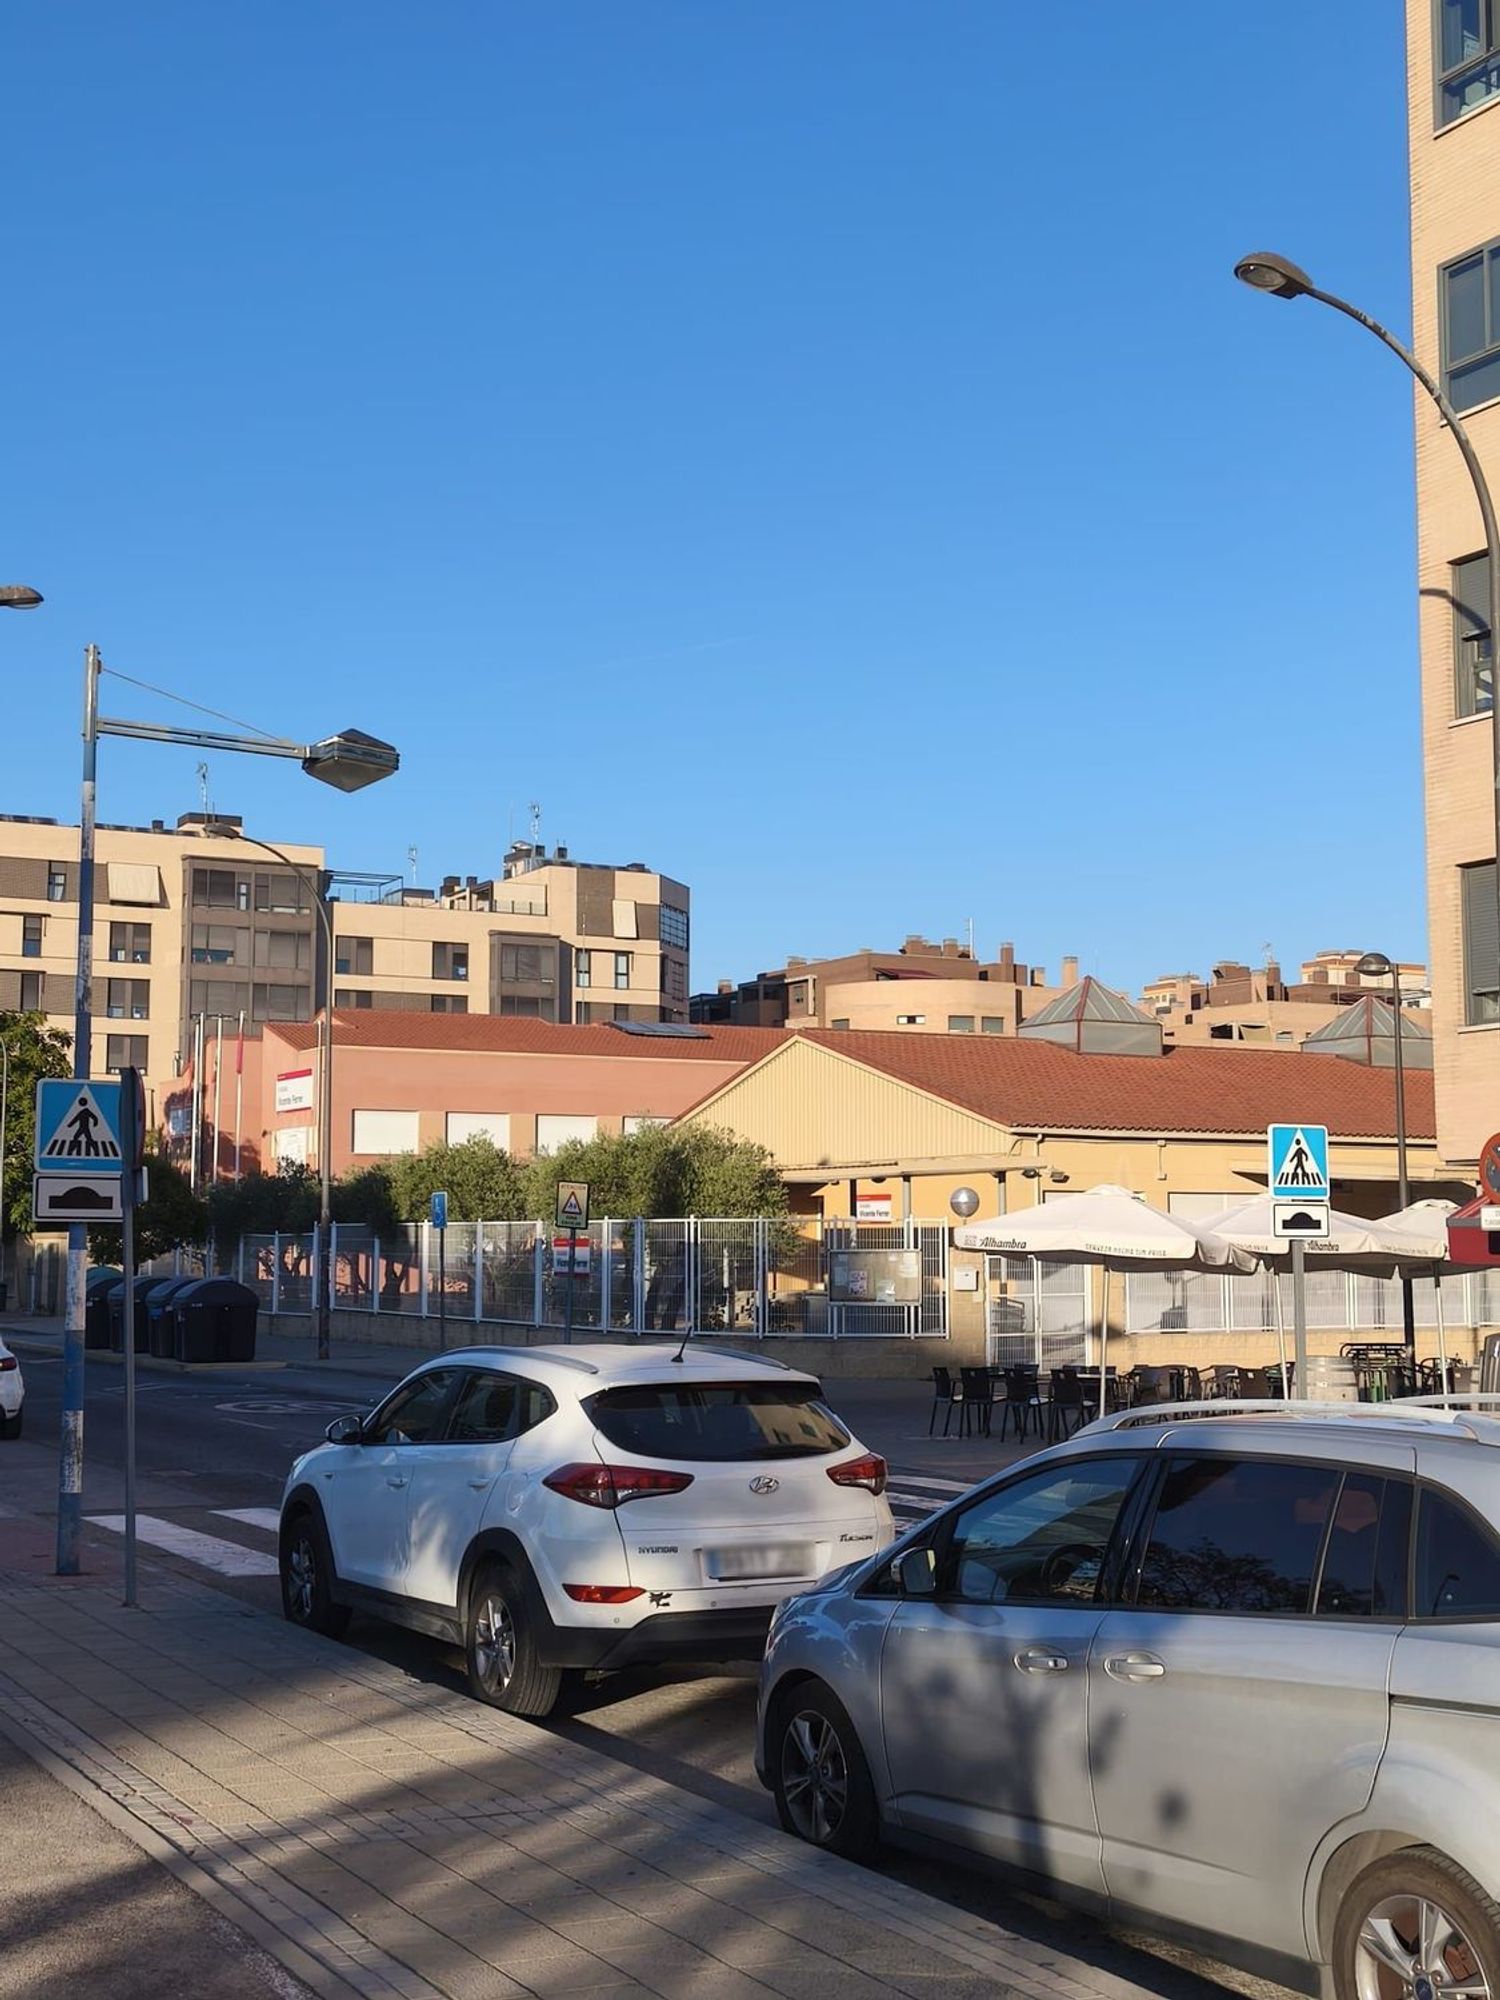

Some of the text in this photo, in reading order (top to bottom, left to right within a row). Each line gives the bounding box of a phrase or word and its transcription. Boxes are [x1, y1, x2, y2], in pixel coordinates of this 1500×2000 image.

[980, 1236, 1027, 1249] Alhambra
[1307, 1240, 1340, 1251] Alhambra
[638, 1546, 679, 1554] HYUNDAI
